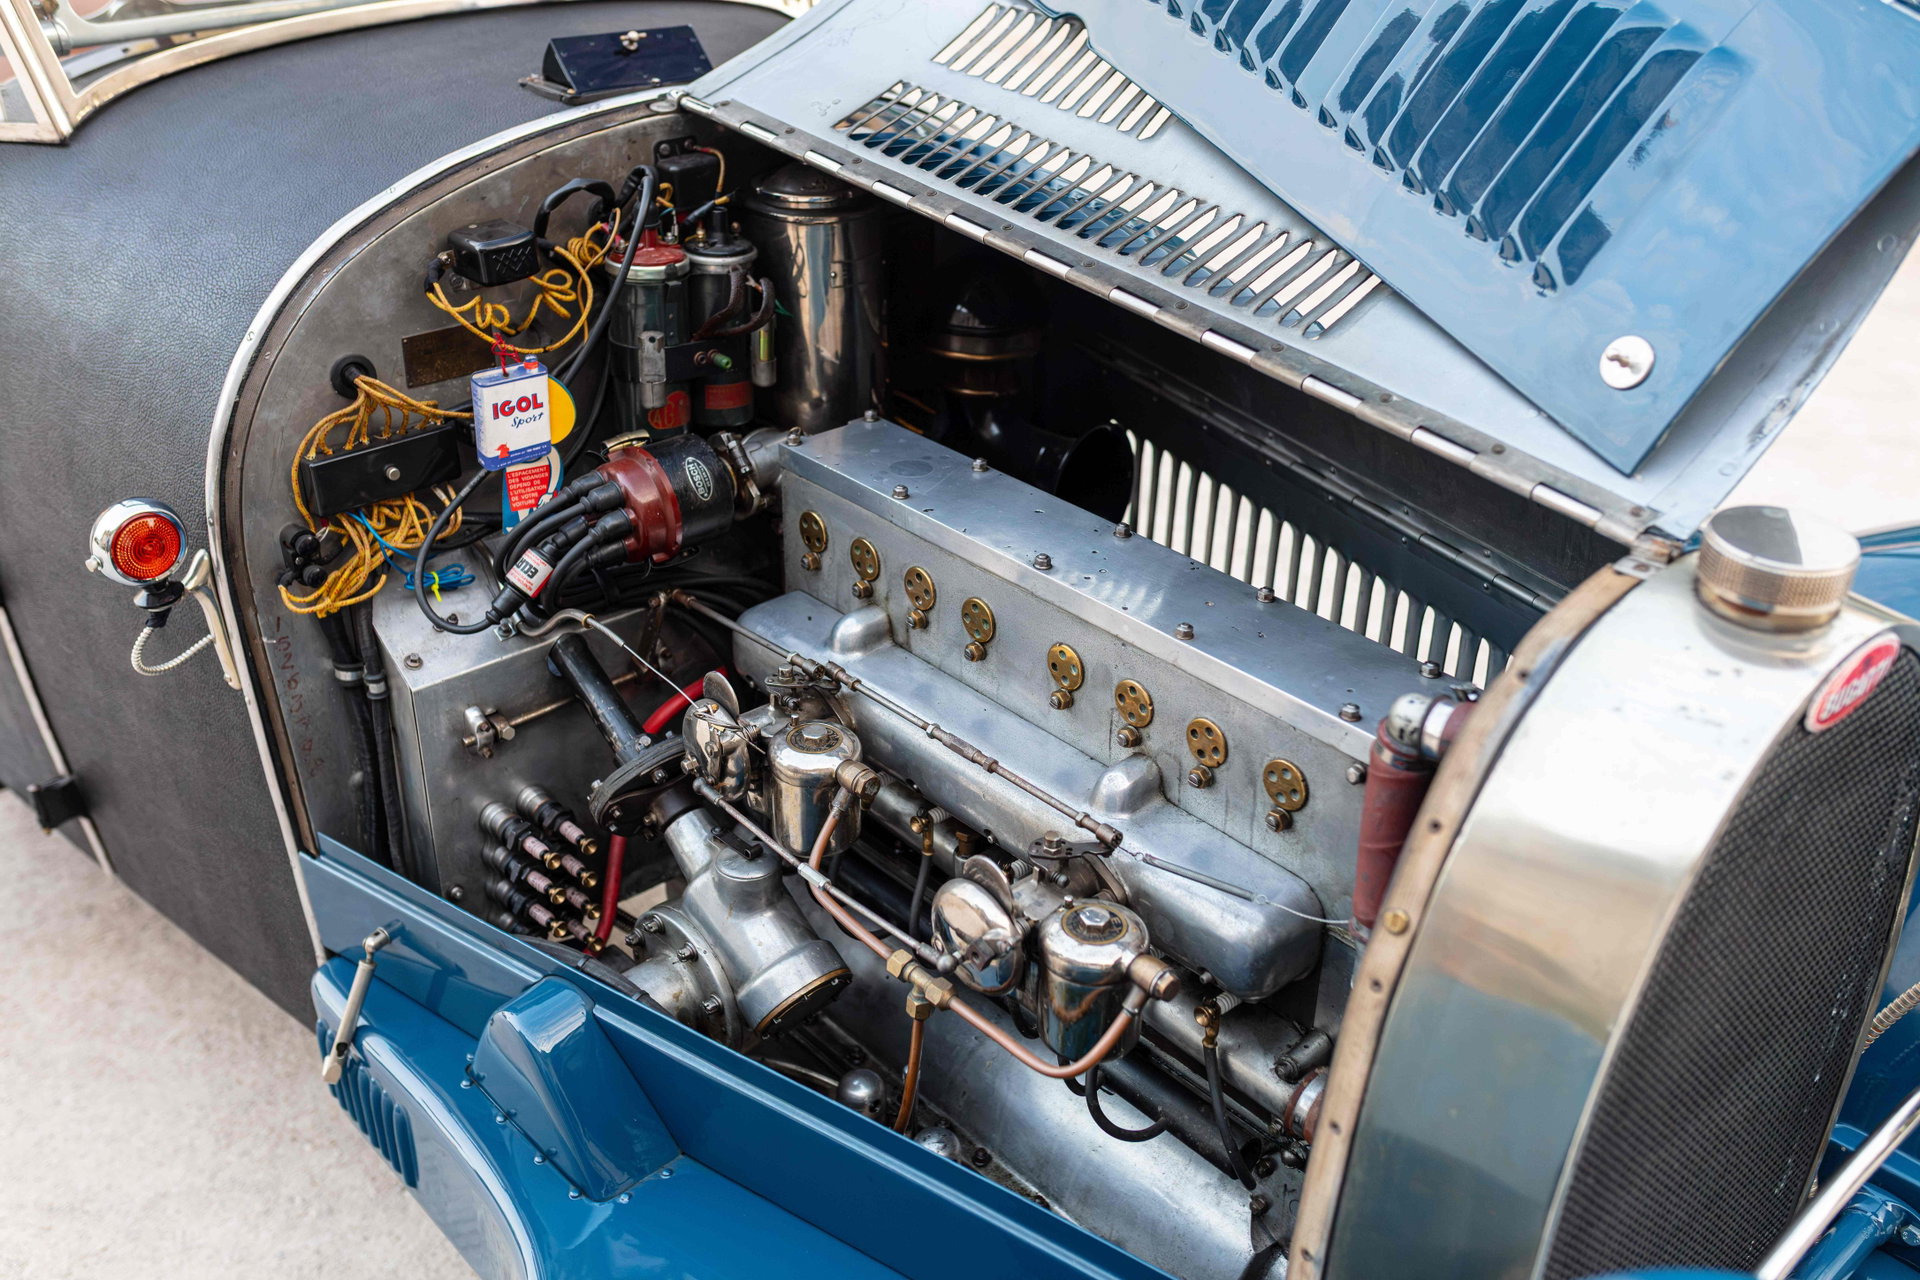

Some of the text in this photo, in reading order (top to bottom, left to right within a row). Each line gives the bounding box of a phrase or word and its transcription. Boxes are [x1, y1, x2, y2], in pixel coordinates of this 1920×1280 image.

[492, 393, 544, 420] IGOL
[511, 411, 544, 429] Sport
[507, 466, 547, 479] L'ESPACEMENT
[521, 472, 549, 482] VIDANGES
[687, 463, 705, 495] BOSCH
[510, 484, 547, 496] L'UTILISATION
[521, 491, 539, 500] VOTRE
[512, 499, 536, 508] VOITURE
